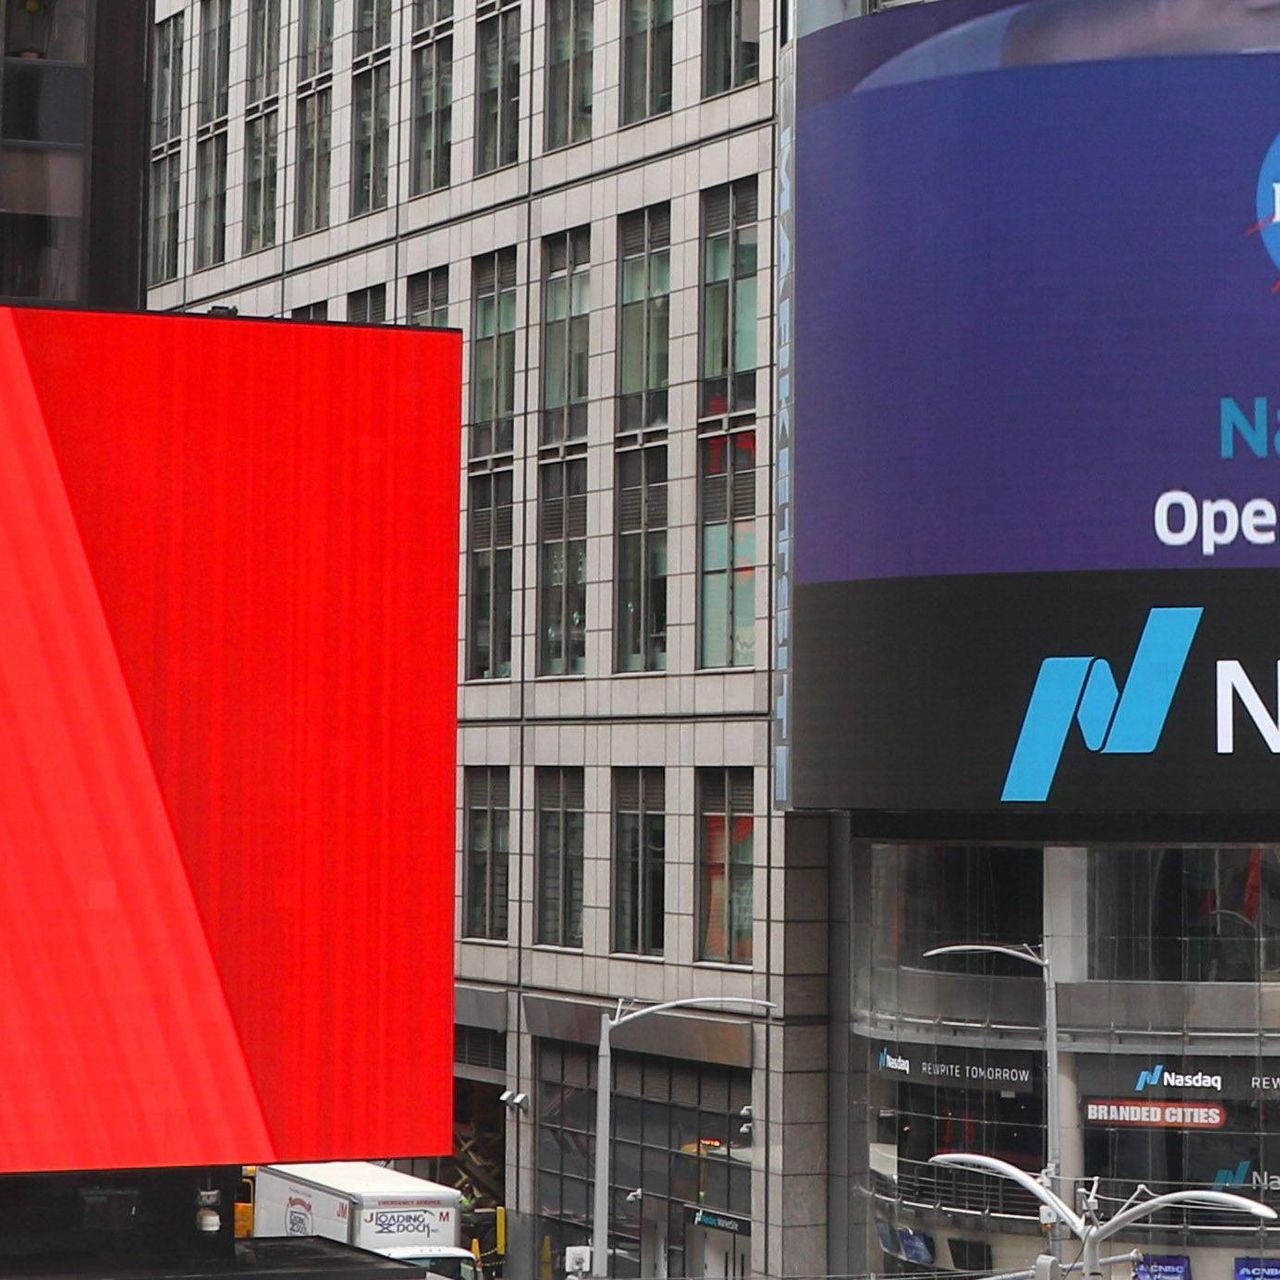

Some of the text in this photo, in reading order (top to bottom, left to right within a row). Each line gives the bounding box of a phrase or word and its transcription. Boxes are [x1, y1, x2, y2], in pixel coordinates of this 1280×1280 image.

[886, 1054, 910, 1074] Nasdaq
[921, 1062, 1030, 1082] REWRITE TOMORROW
[1163, 1071, 1223, 1091] Nasdaq
[1087, 1104, 1221, 1124] BRANDED CITIES
[364, 1212, 374, 1224] J
[439, 1212, 450, 1223] M
[396, 1223, 431, 1238] DOCK
